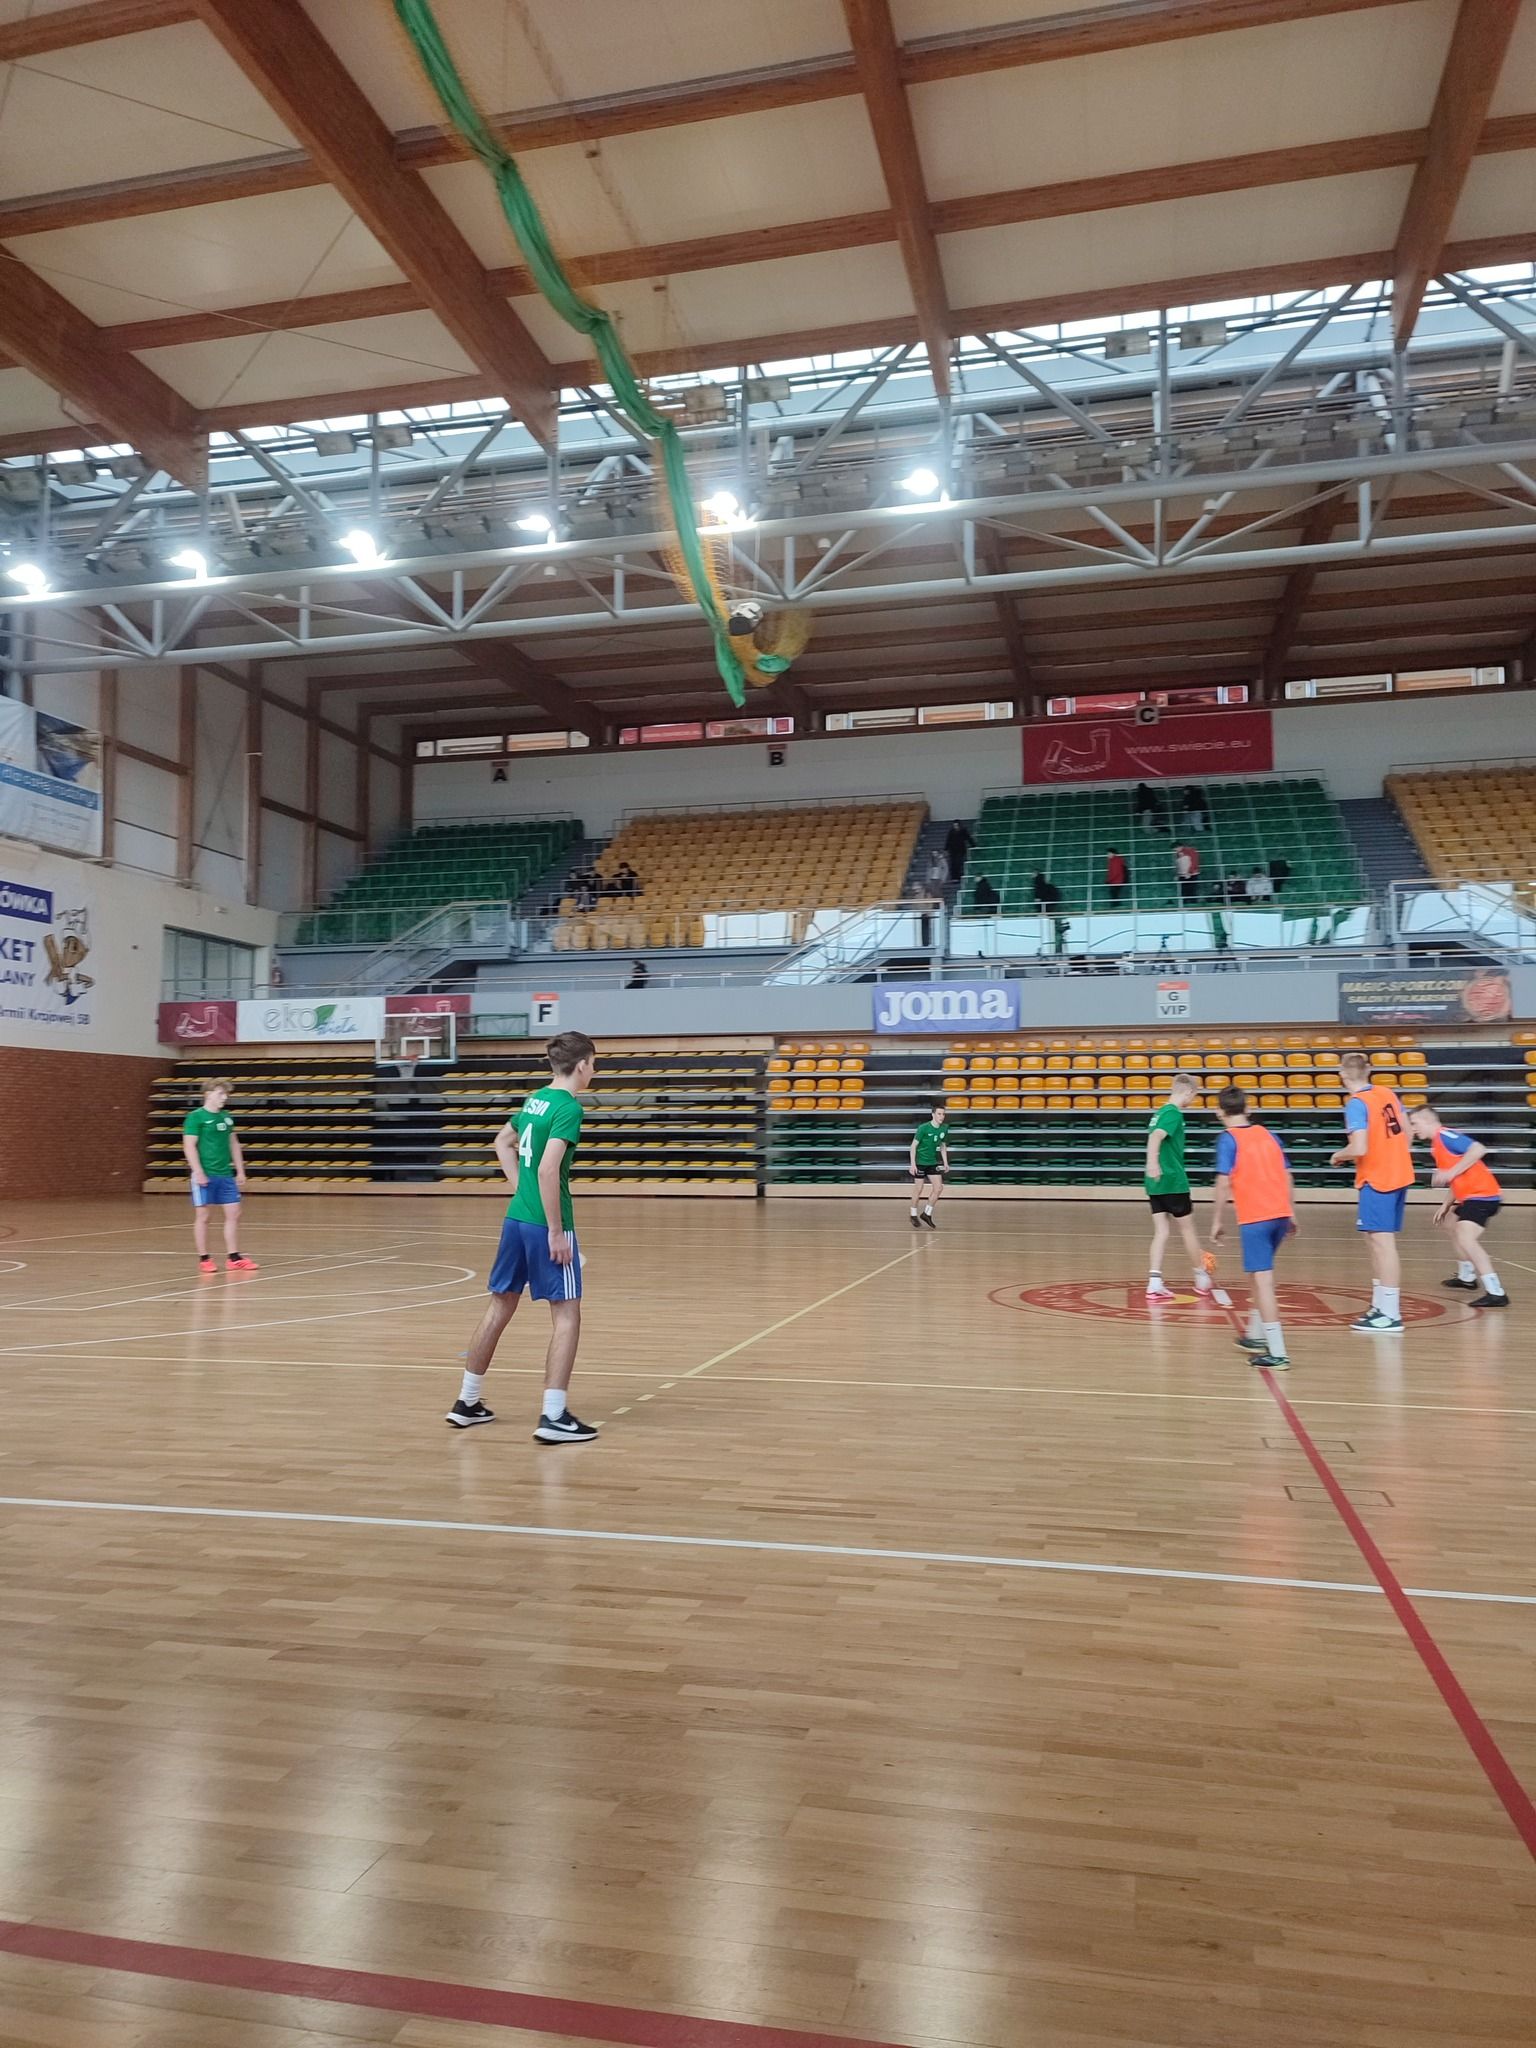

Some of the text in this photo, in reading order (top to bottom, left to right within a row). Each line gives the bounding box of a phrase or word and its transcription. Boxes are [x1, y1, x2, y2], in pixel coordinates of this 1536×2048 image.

[1140, 707, 1154, 723] C
[770, 751, 784, 765] B
[493, 768, 507, 782] A
[1168, 991, 1180, 1001] G
[263, 1003, 320, 1032] eko
[539, 1003, 552, 1023] F
[1160, 1005, 1187, 1015] VIP
[519, 1122, 533, 1168] 4
